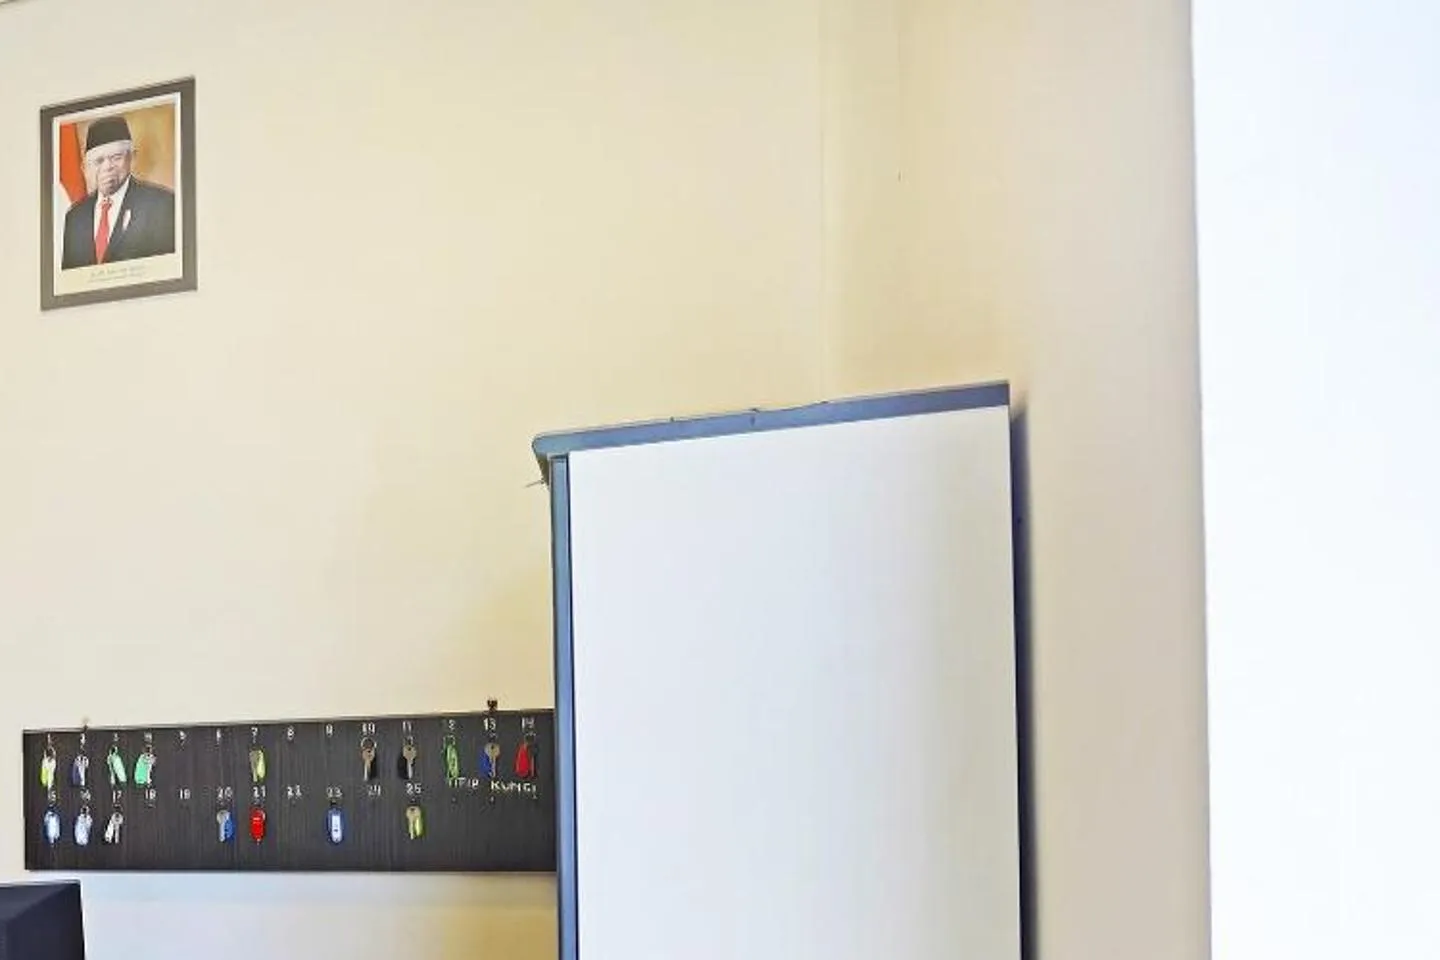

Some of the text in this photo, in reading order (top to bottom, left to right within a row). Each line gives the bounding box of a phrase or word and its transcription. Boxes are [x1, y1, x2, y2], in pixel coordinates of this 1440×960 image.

[287, 726, 295, 741] 8
[112, 790, 122, 803] 17
[406, 782, 422, 795] 25
